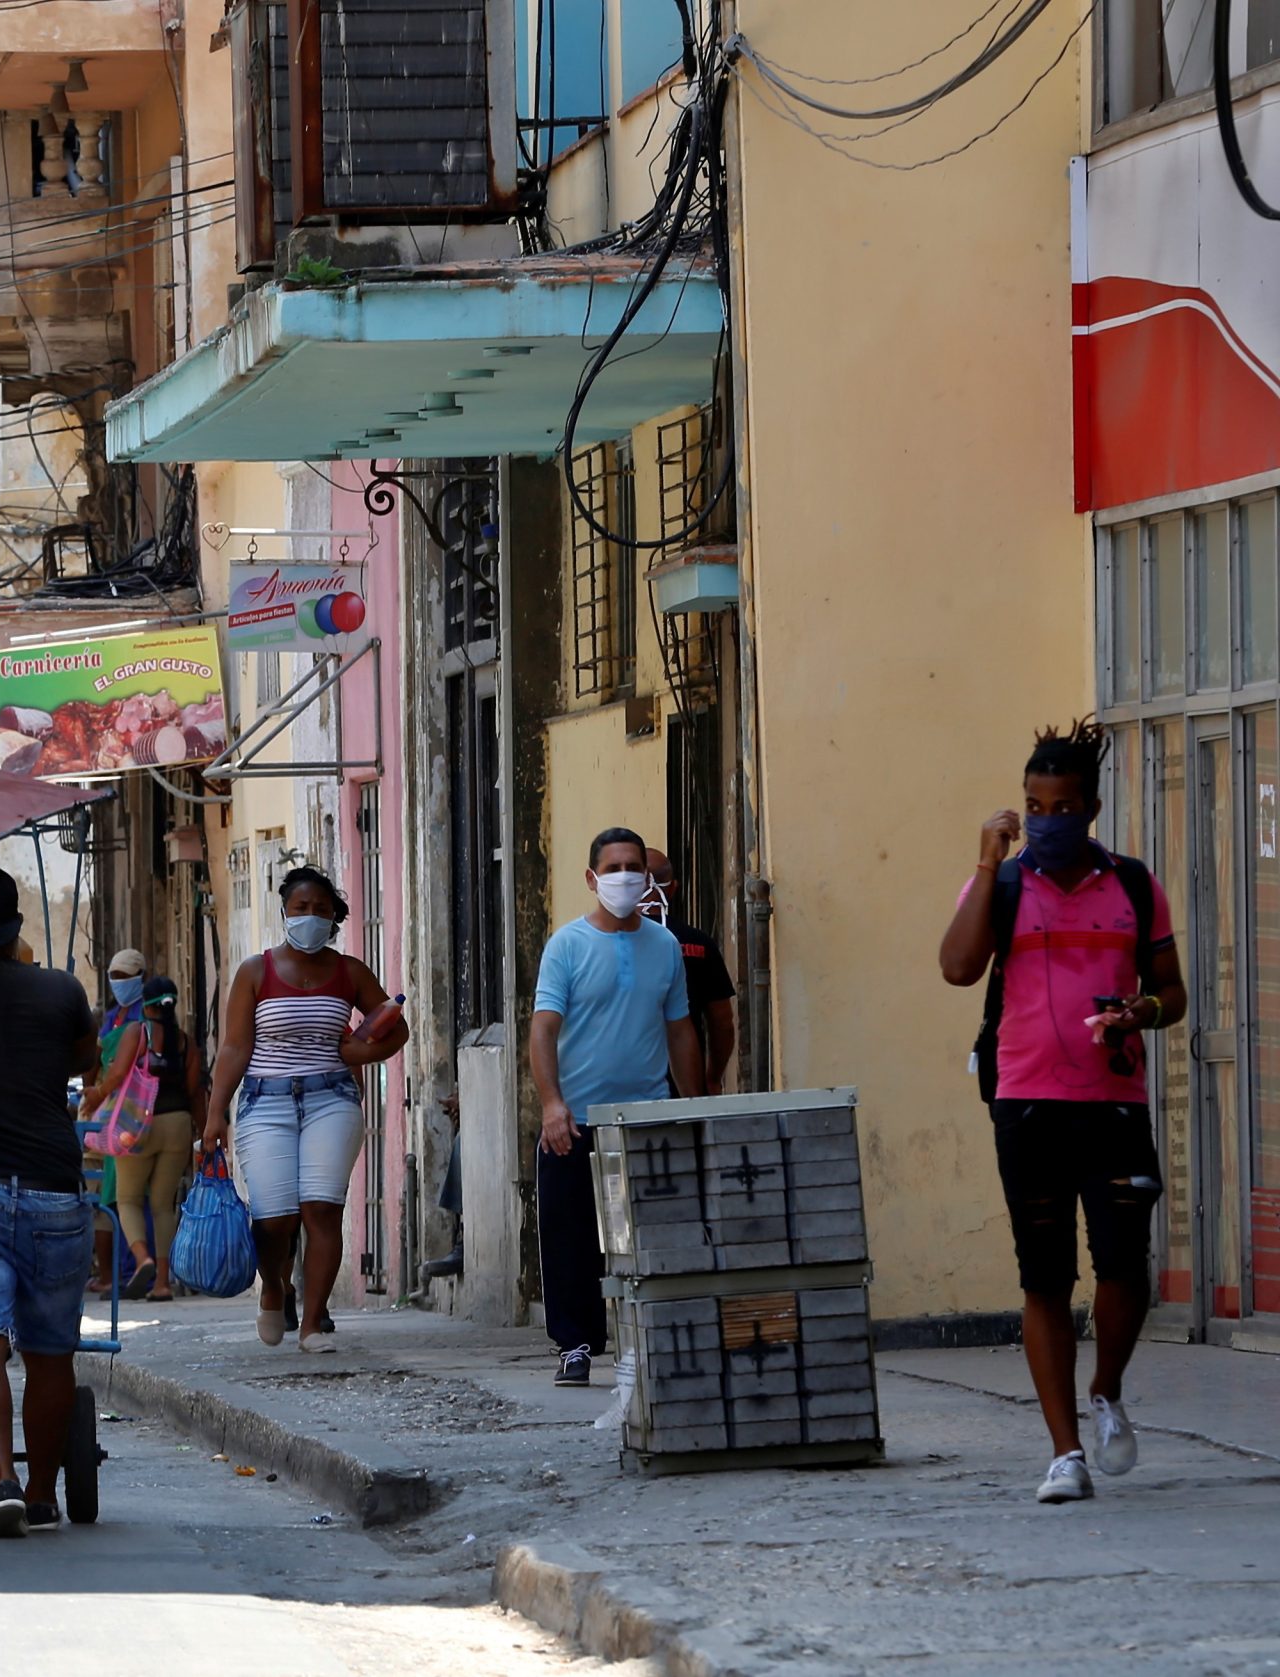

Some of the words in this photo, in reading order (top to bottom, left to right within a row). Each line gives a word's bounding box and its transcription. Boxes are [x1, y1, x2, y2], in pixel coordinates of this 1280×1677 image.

[247, 568, 346, 605] Armonía
[259, 611, 273, 621] para
[0, 647, 102, 678] Carnicería
[93, 675, 114, 692] EL
[113, 658, 157, 681] GRAN
[160, 657, 213, 679] GUSTO
